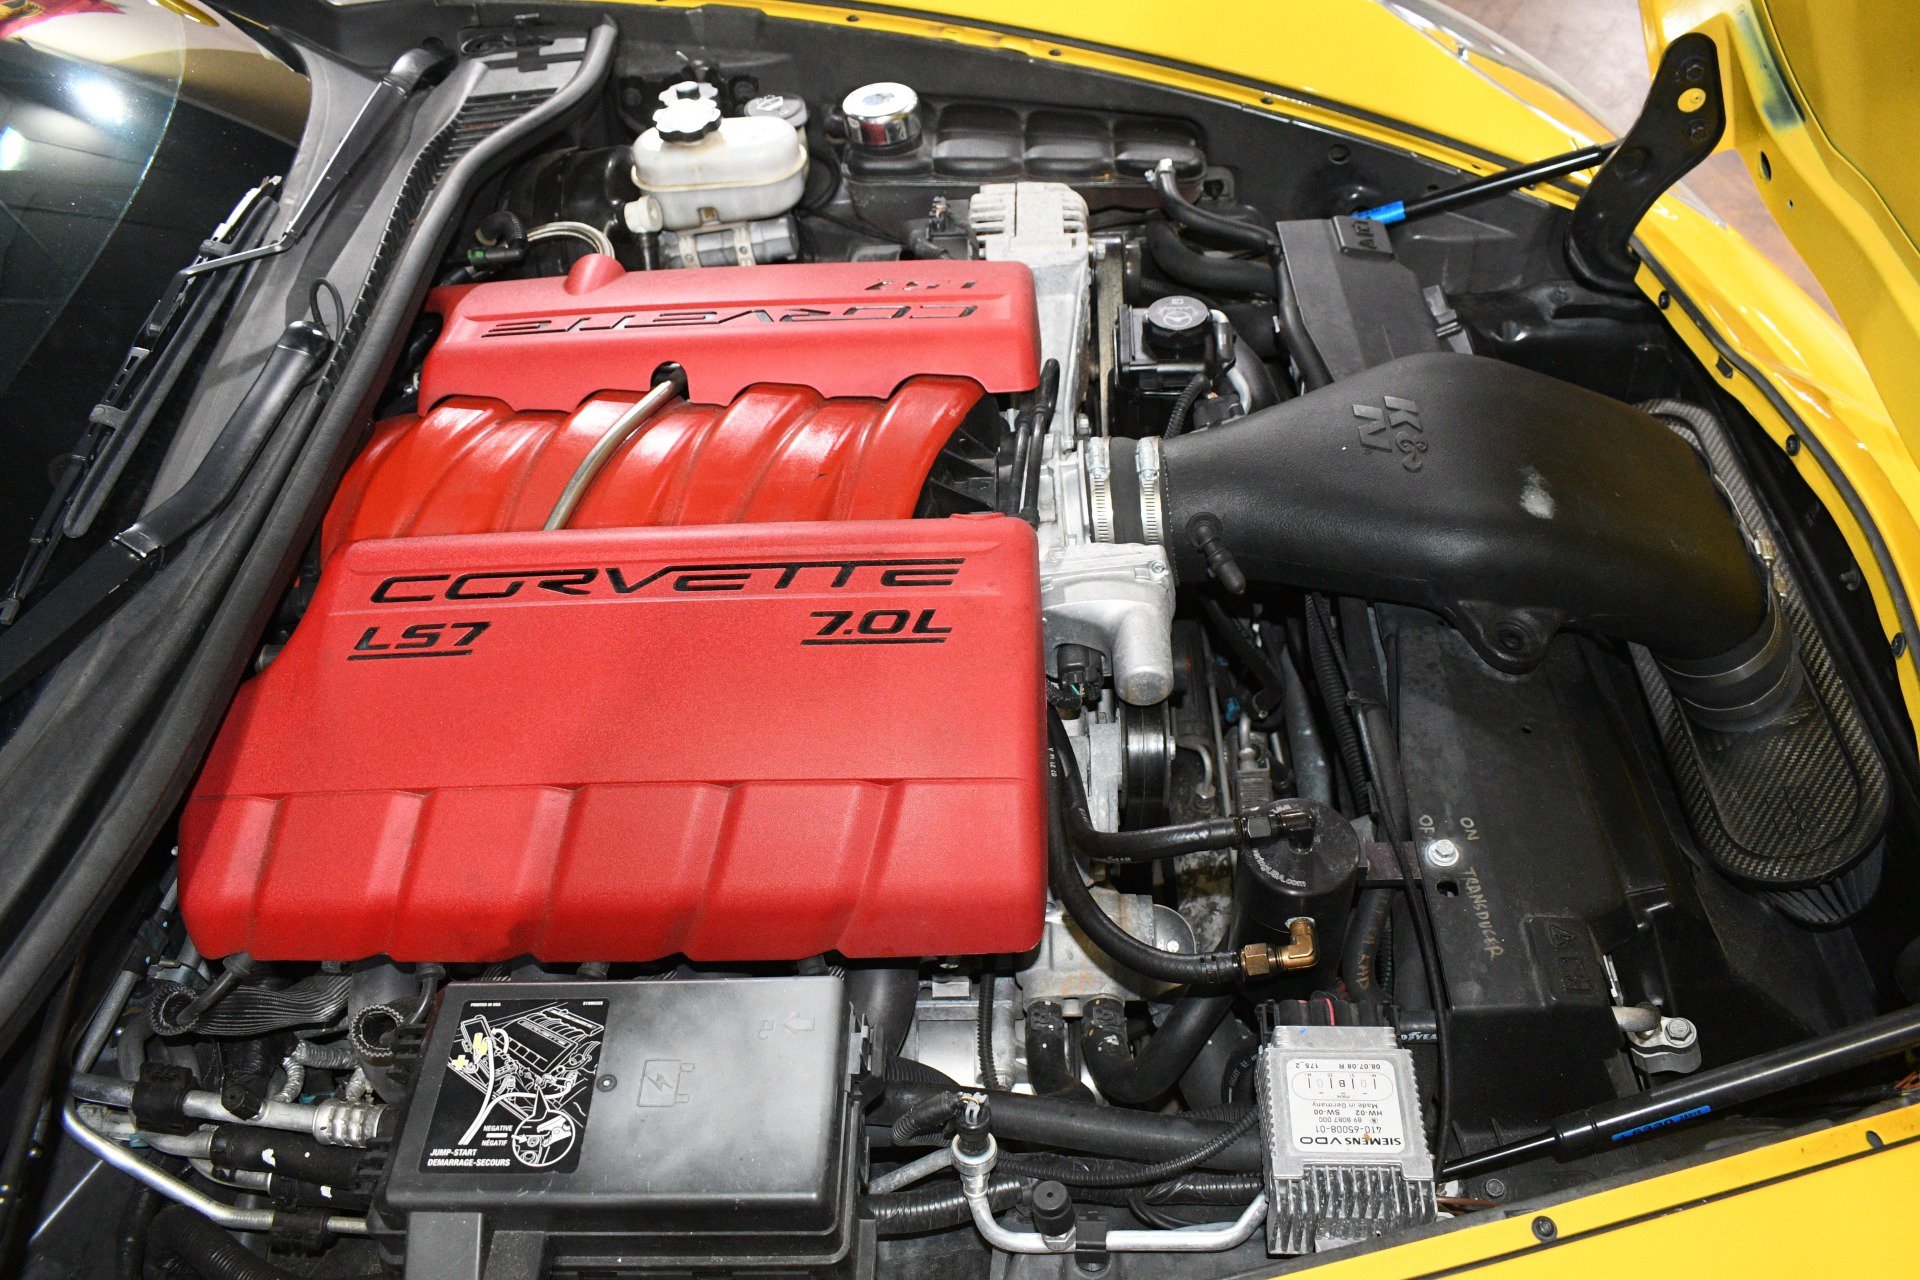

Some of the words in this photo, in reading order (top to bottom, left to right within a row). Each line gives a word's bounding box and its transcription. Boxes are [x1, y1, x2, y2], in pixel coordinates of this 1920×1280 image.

[481, 304, 979, 338] CORVETTE
[371, 557, 966, 604] CORVETTE
[810, 609, 953, 636] 7.0L
[353, 620, 491, 652] LS7
[1459, 816, 1480, 841] ON
[1338, 1079, 1346, 1087] B
[483, 1124, 514, 1132] NEGATIVE
[1315, 1125, 1382, 1133] 410-65008-01
[1299, 1136, 1342, 1145] VDO
[1345, 1137, 1402, 1146] SIEMENS
[429, 1148, 478, 1157] JUMP-START
[427, 1157, 511, 1167] DEMARRAGE-SECOURS
